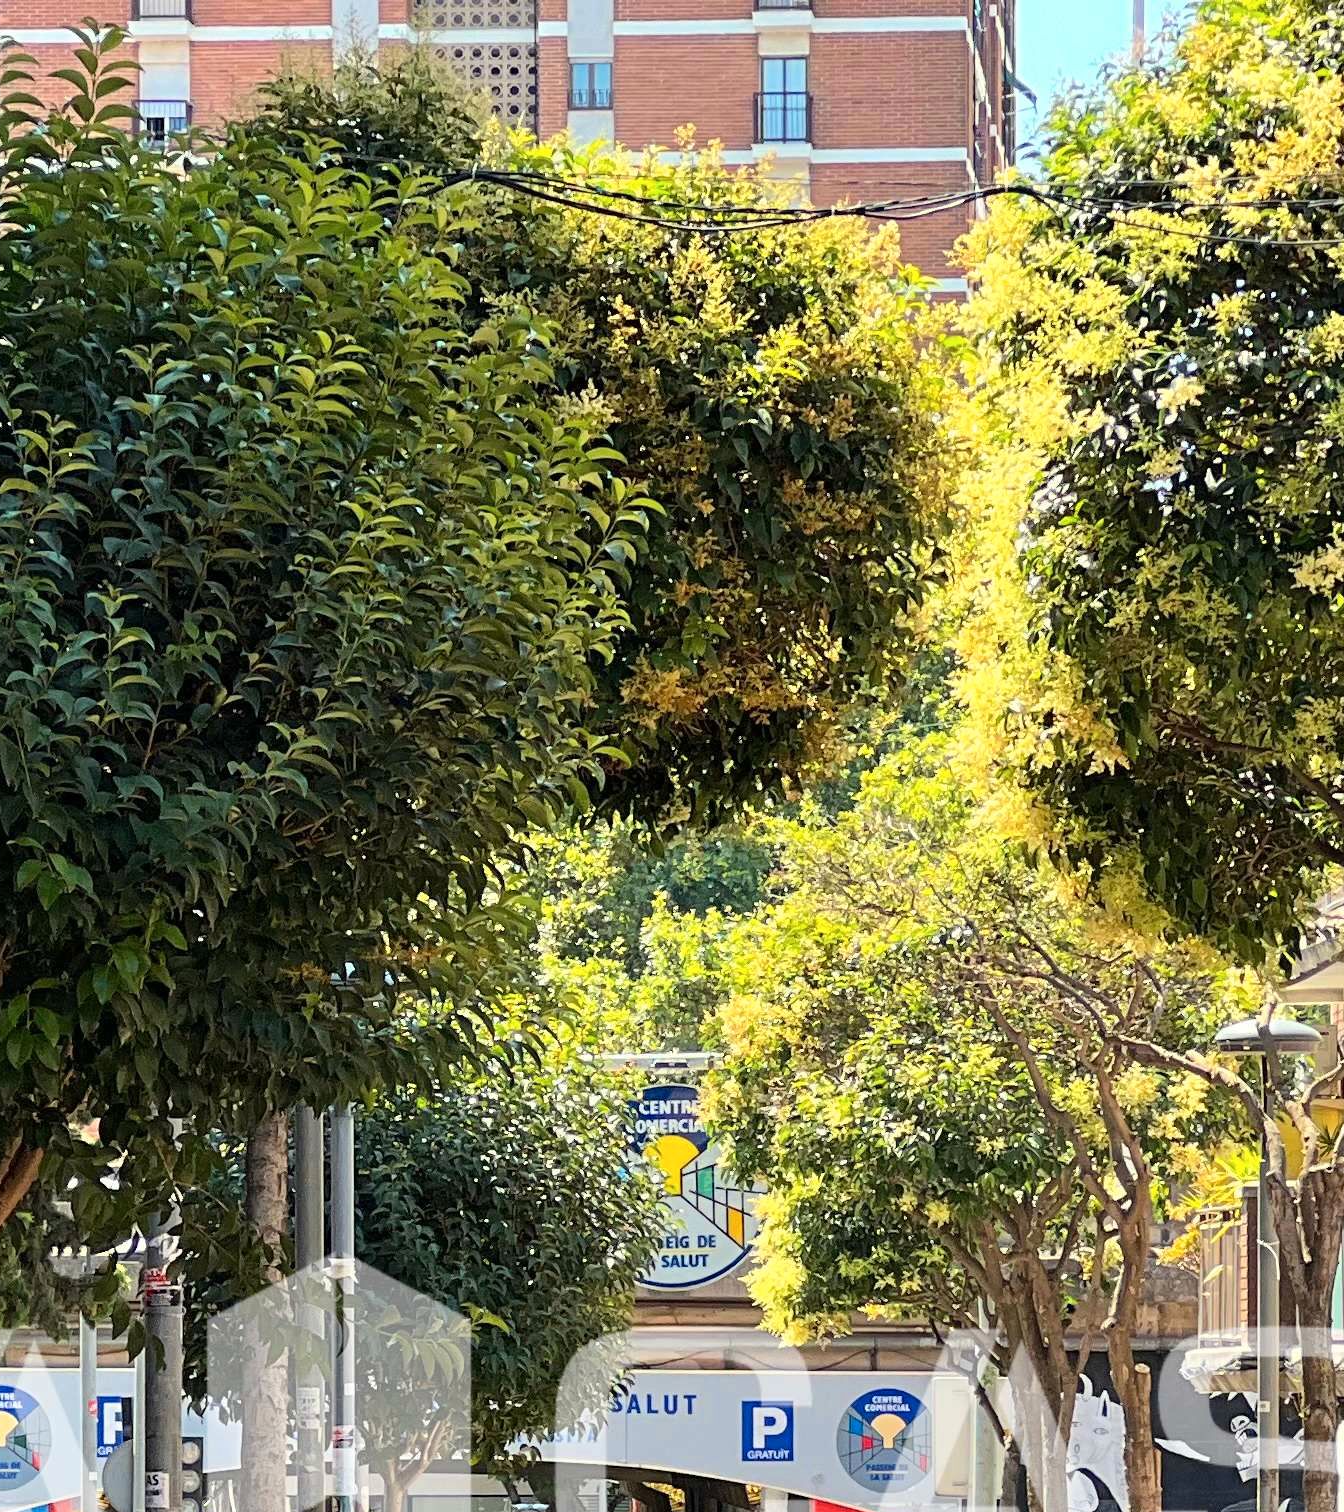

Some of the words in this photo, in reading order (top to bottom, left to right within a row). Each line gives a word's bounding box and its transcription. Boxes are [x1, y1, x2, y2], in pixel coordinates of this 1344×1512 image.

[697, 1235, 716, 1248] DE
[661, 1254, 708, 1268] SALUT
[610, 1394, 697, 1415] SALUT
[871, 1395, 903, 1404] CENTRE
[864, 1404, 911, 1412] COMERCIAL
[752, 1406, 788, 1449] P
